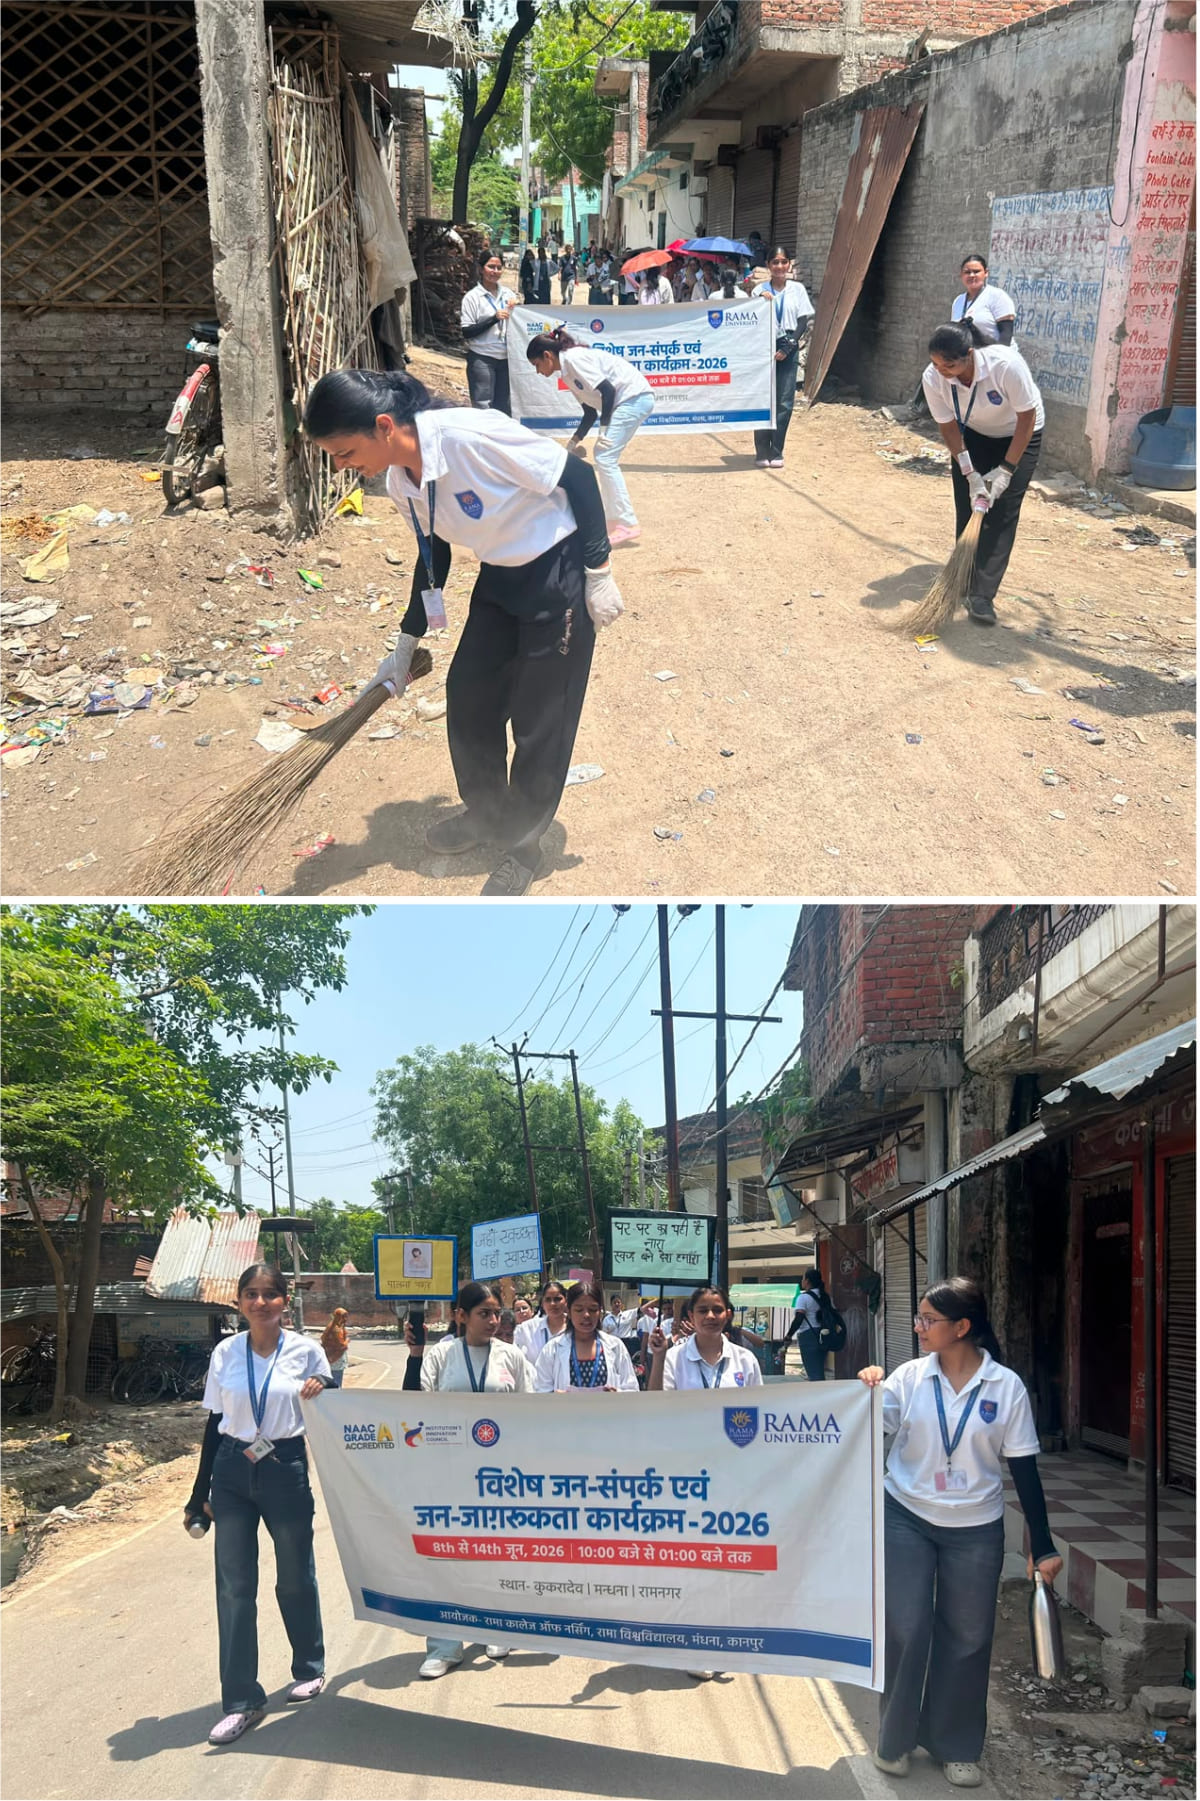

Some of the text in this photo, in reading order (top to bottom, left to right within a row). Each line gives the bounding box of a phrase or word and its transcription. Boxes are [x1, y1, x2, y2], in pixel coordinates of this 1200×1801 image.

[1145, 172, 1191, 188] Photo Cake
[725, 312, 758, 321] RAMA
[683, 340, 702, 355] एवं
[644, 1238, 665, 1249] नारा
[344, 1424, 375, 1433] NAAC
[764, 1413, 841, 1432] RAMA
[344, 1433, 376, 1442] GRADE
[764, 1433, 842, 1444] UNIVERSITY
[345, 1442, 394, 1450] ACCREDITED
[475, 1466, 711, 1500] विशेष जन-संपर्क एवं
[432, 1539, 752, 1564] 8th से 14th जून, 2026 10:00 बजे से 01:00 बजे तक
[499, 1579, 682, 1600] स्थान- कुकरादेव मन्धना रामनगर
[440, 1610, 481, 1623] आयोजक-
[484, 1617, 503, 1627] रामा
[505, 1619, 536, 1631] कालेज
[539, 1621, 561, 1633] ऑफ
[597, 1627, 617, 1639] रामा
[620, 1627, 688, 1646] विश्वविद्यालय,
[692, 1634, 723, 1648] मंधना,
[727, 1637, 765, 1651] कानपुर
